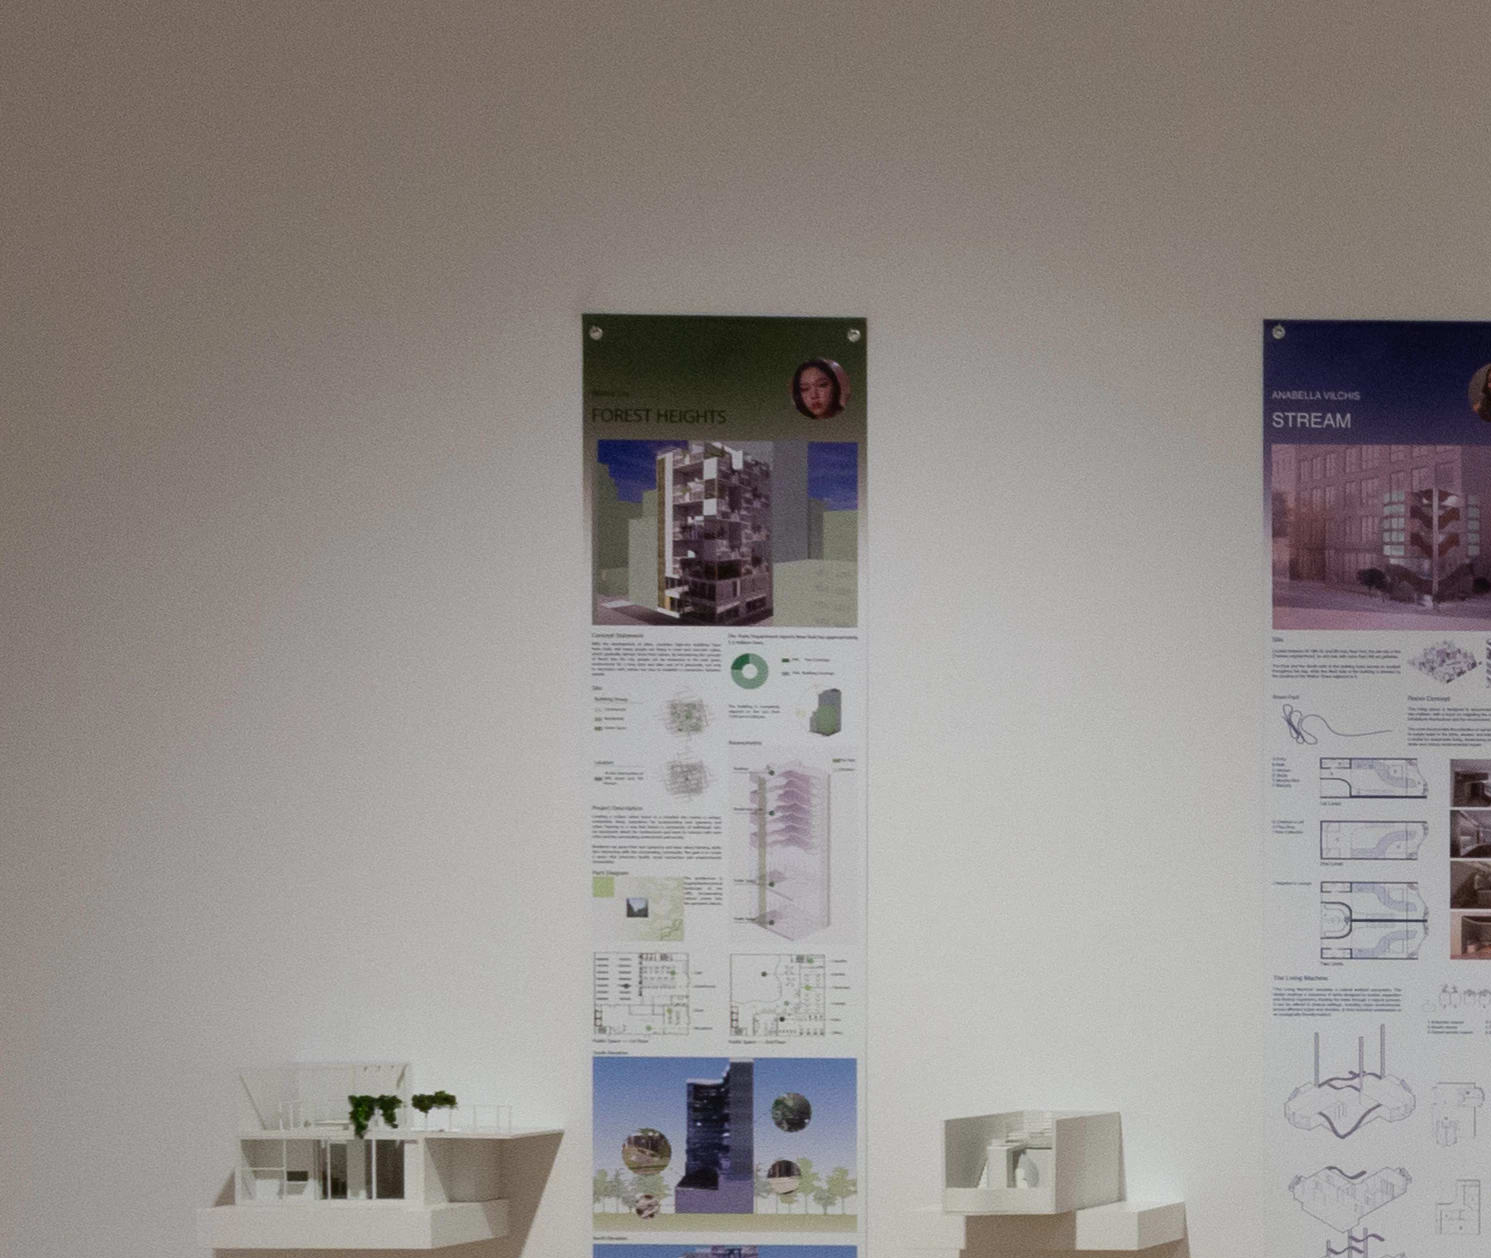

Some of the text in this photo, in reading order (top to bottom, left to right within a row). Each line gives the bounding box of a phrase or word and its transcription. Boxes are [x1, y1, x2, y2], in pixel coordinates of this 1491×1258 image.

[592, 408, 727, 424] FOREST HEIGHTS
[1272, 412, 1352, 428] STREAM
